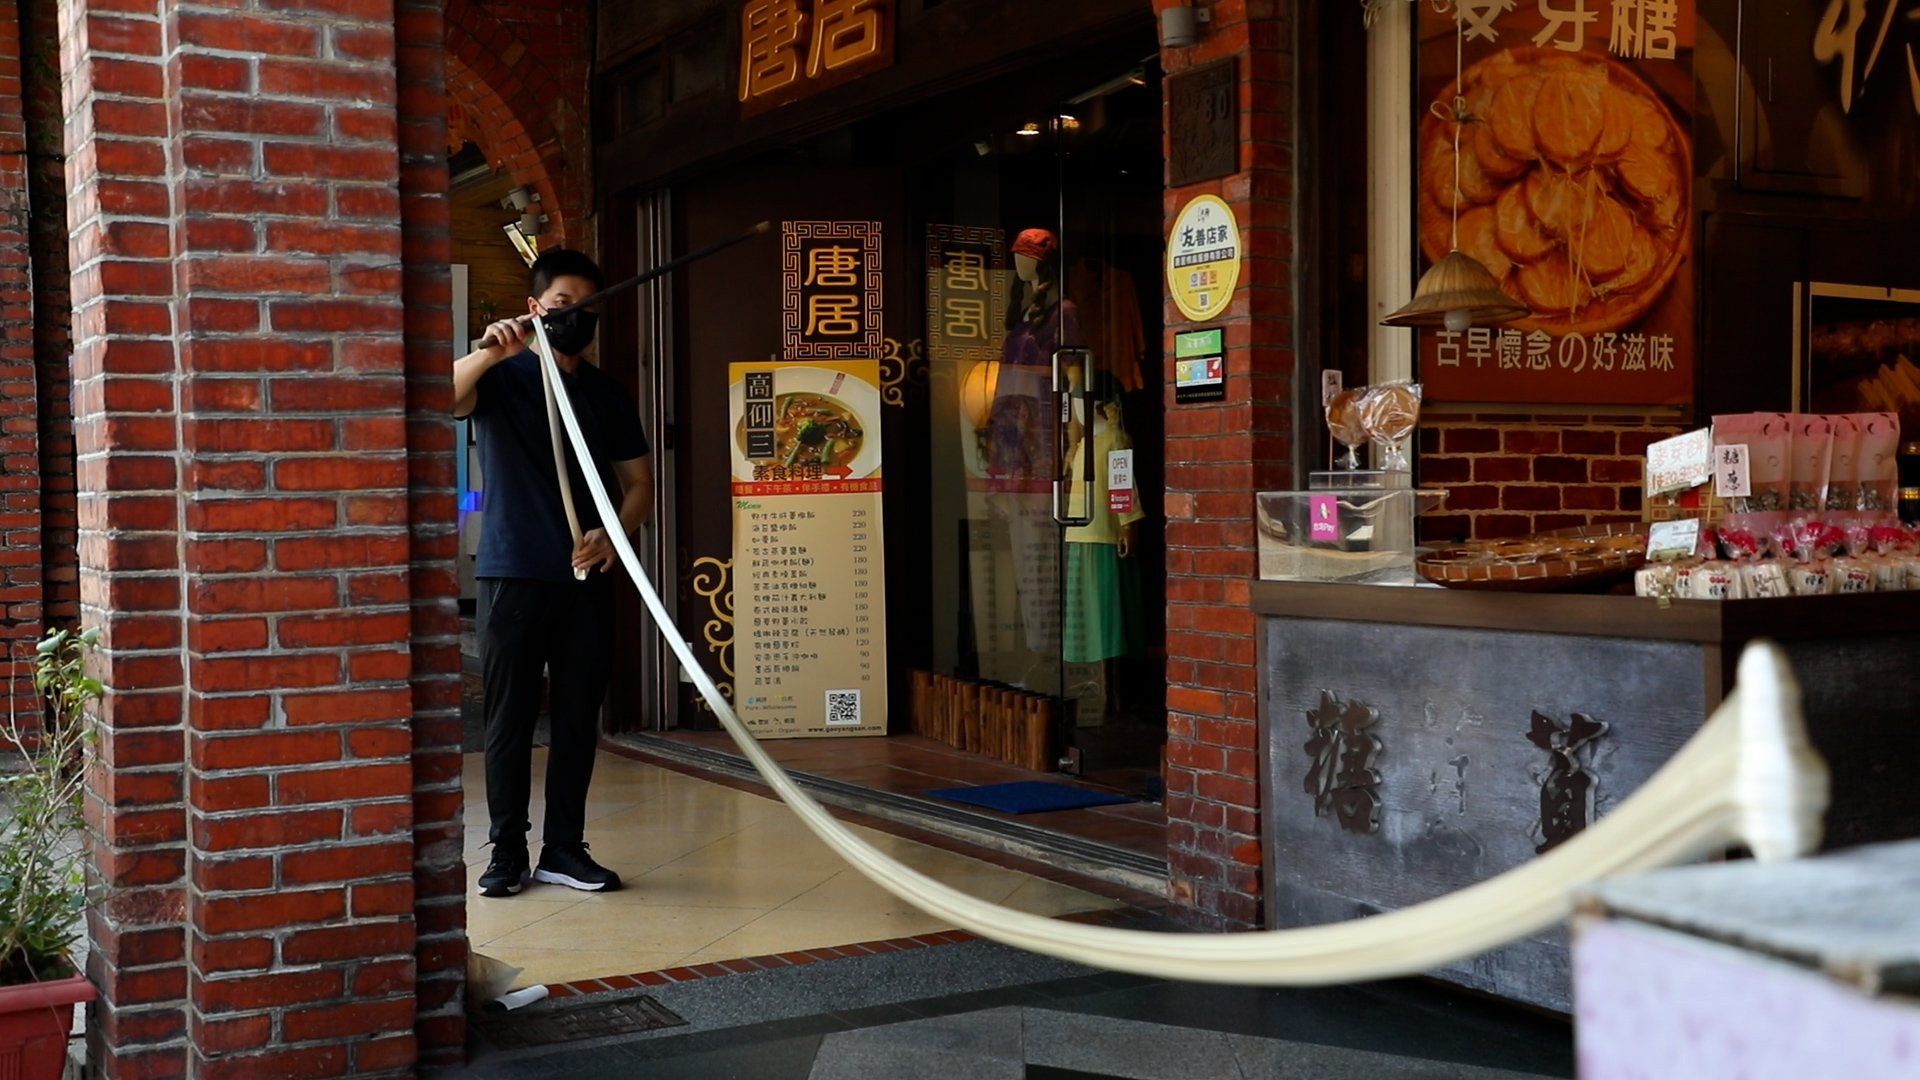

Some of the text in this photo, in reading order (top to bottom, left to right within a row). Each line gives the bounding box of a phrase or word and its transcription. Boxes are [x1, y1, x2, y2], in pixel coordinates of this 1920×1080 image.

[1181, 224, 1229, 248] 友善店家
[804, 245, 861, 336] 唐居
[1435, 328, 1675, 373] 古早懷念の好滋味
[747, 374, 772, 456] 高仰三
[1112, 457, 1128, 470] OPEN
[753, 465, 823, 482] 素食料理
[764, 484, 792, 494] 下午茶
[736, 501, 762, 509] Menu
[808, 724, 882, 734] www.gaoyangsan.com
